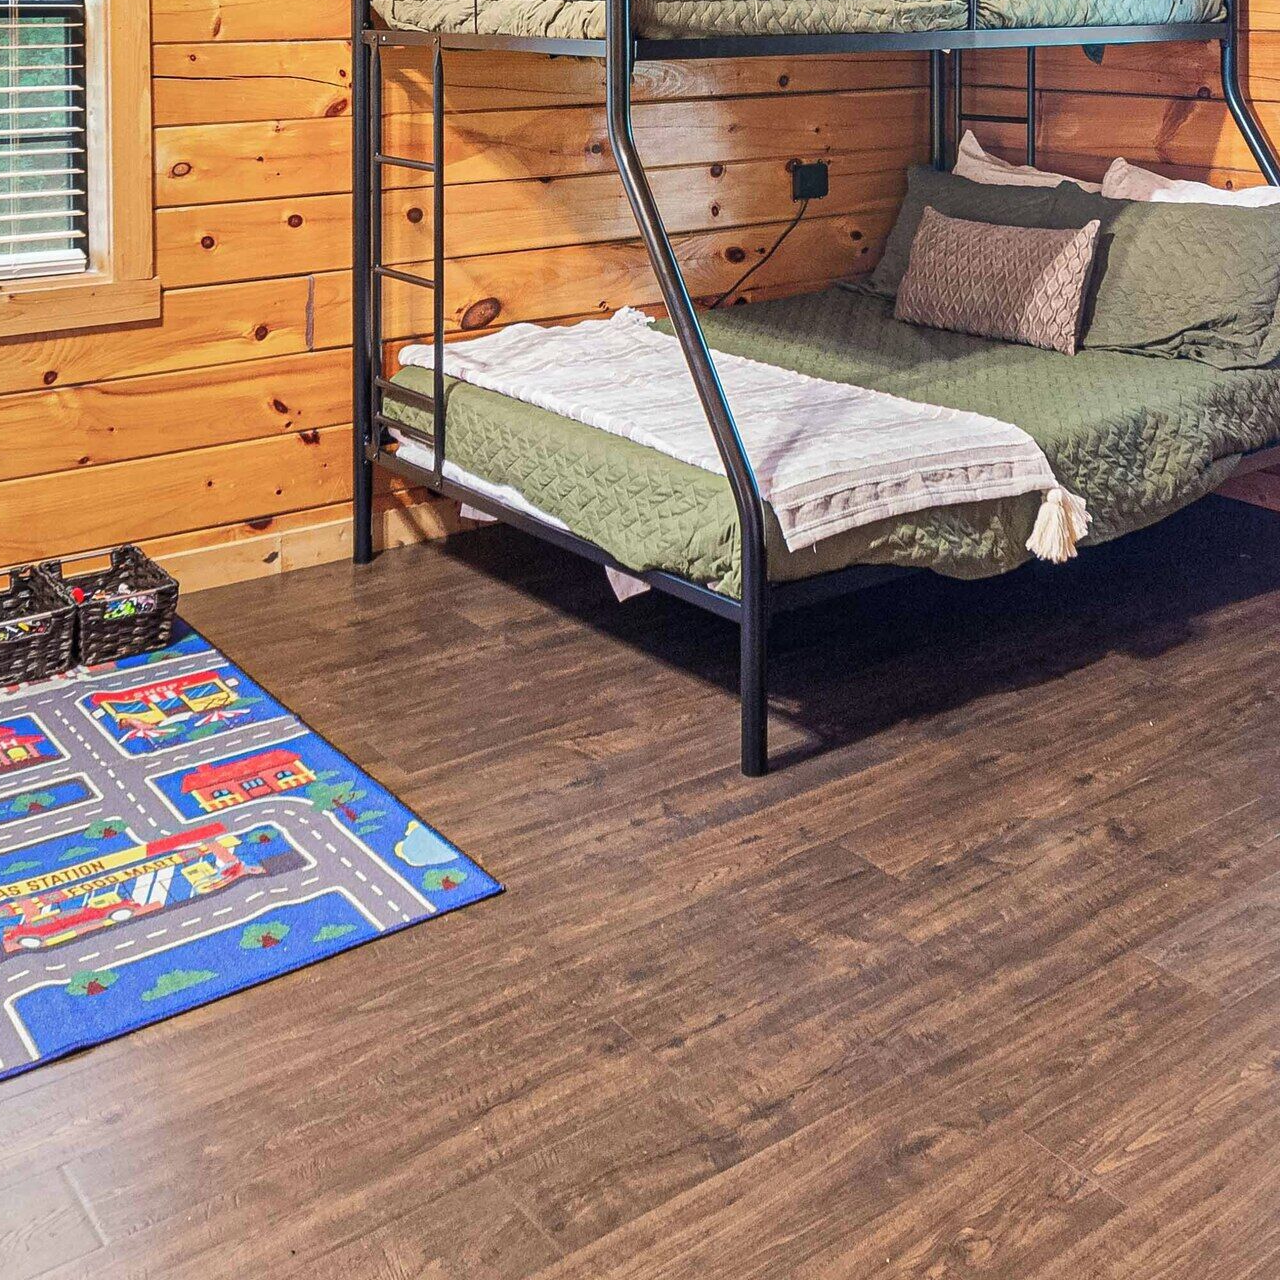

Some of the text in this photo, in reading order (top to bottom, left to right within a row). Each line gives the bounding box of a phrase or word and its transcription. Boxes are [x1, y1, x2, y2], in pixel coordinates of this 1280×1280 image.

[133, 683, 179, 700] SHOP
[27, 860, 106, 892] STATION
[68, 856, 177, 898] FOOD MART
